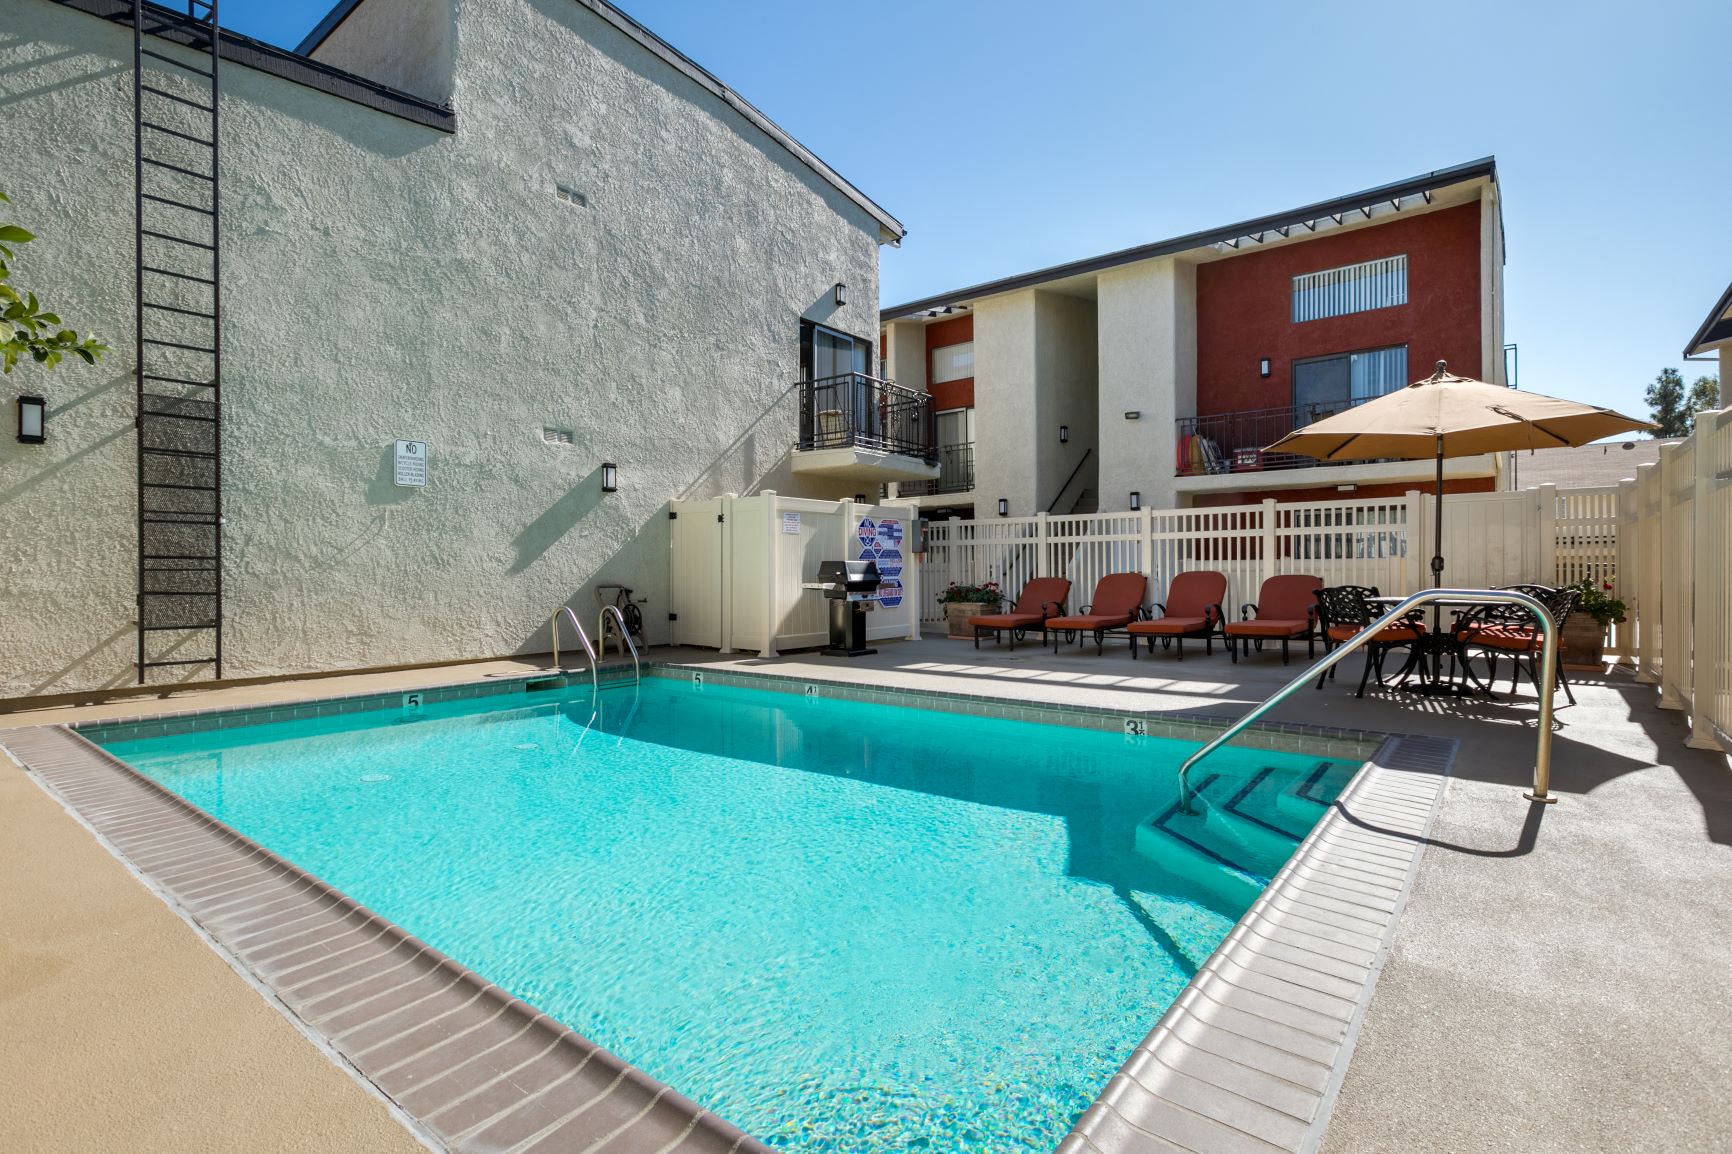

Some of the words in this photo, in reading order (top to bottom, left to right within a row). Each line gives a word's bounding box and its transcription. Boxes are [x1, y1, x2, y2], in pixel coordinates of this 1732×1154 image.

[406, 444, 417, 454] NO
[864, 518, 871, 527] NO
[858, 528, 876, 536] DIVING
[695, 673, 701, 686] 5
[408, 694, 418, 706] 5
